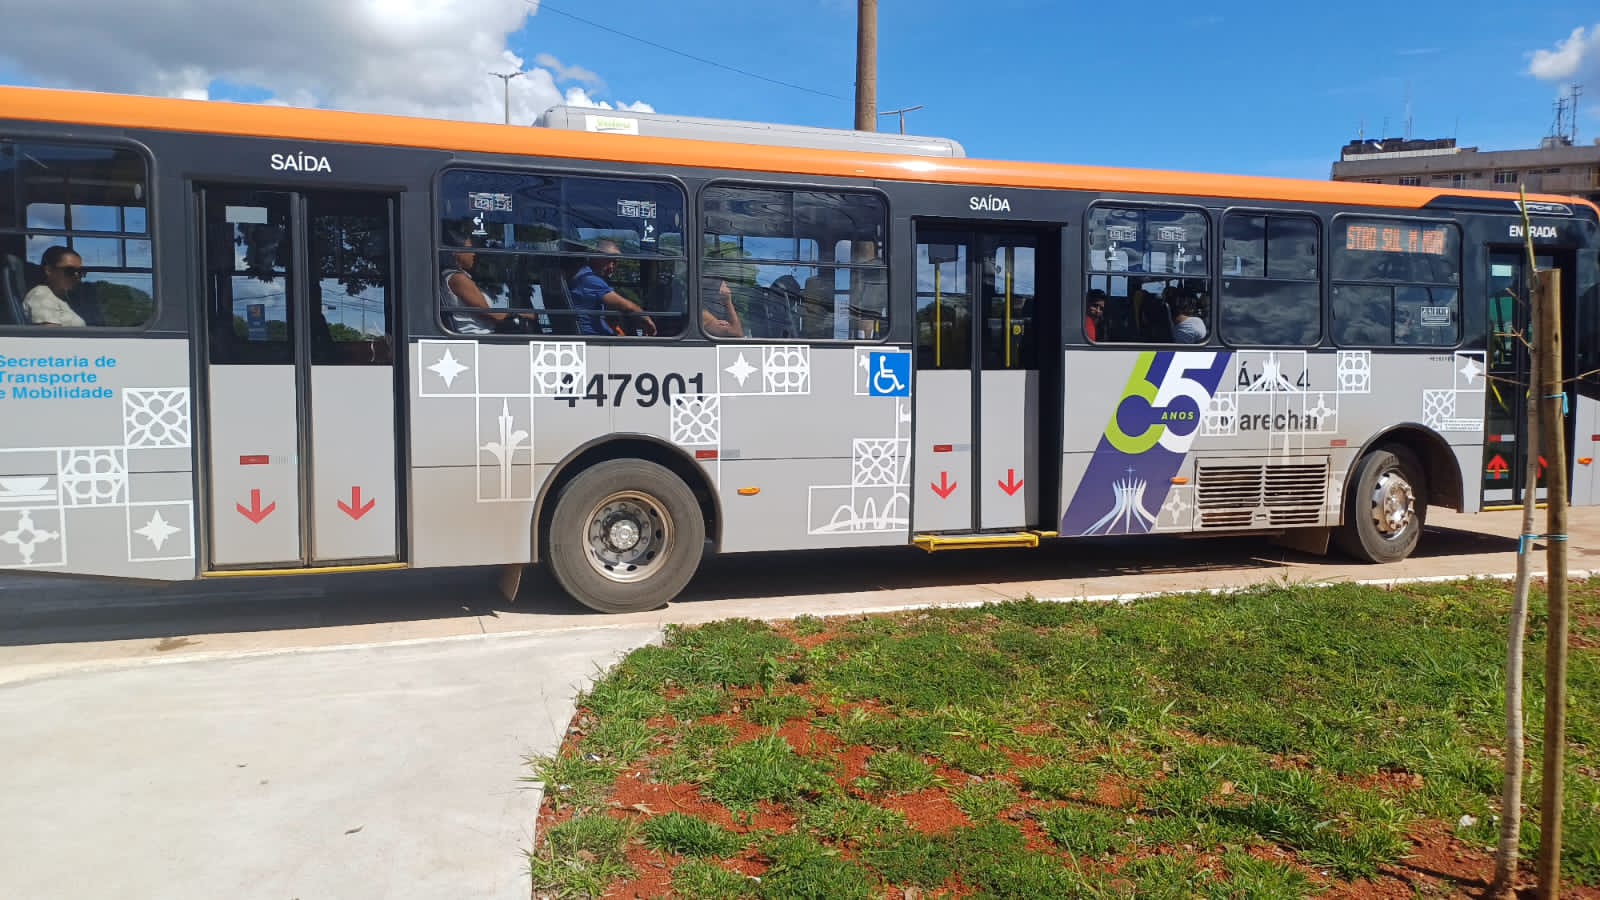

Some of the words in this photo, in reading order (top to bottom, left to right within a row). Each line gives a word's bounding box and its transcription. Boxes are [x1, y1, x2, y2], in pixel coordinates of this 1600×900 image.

[271, 151, 332, 173] SAÍDA
[969, 194, 1011, 212] SAÍDA
[1509, 225, 1557, 238] ENRADA
[0, 354, 88, 368] Secretaria
[95, 355, 117, 368] de
[0, 371, 97, 385] Transporte
[1297, 368, 1311, 392] 4
[12, 386, 113, 399] Mobilidade
[554, 372, 703, 408] 447901
[1161, 411, 1195, 421] ANOS
